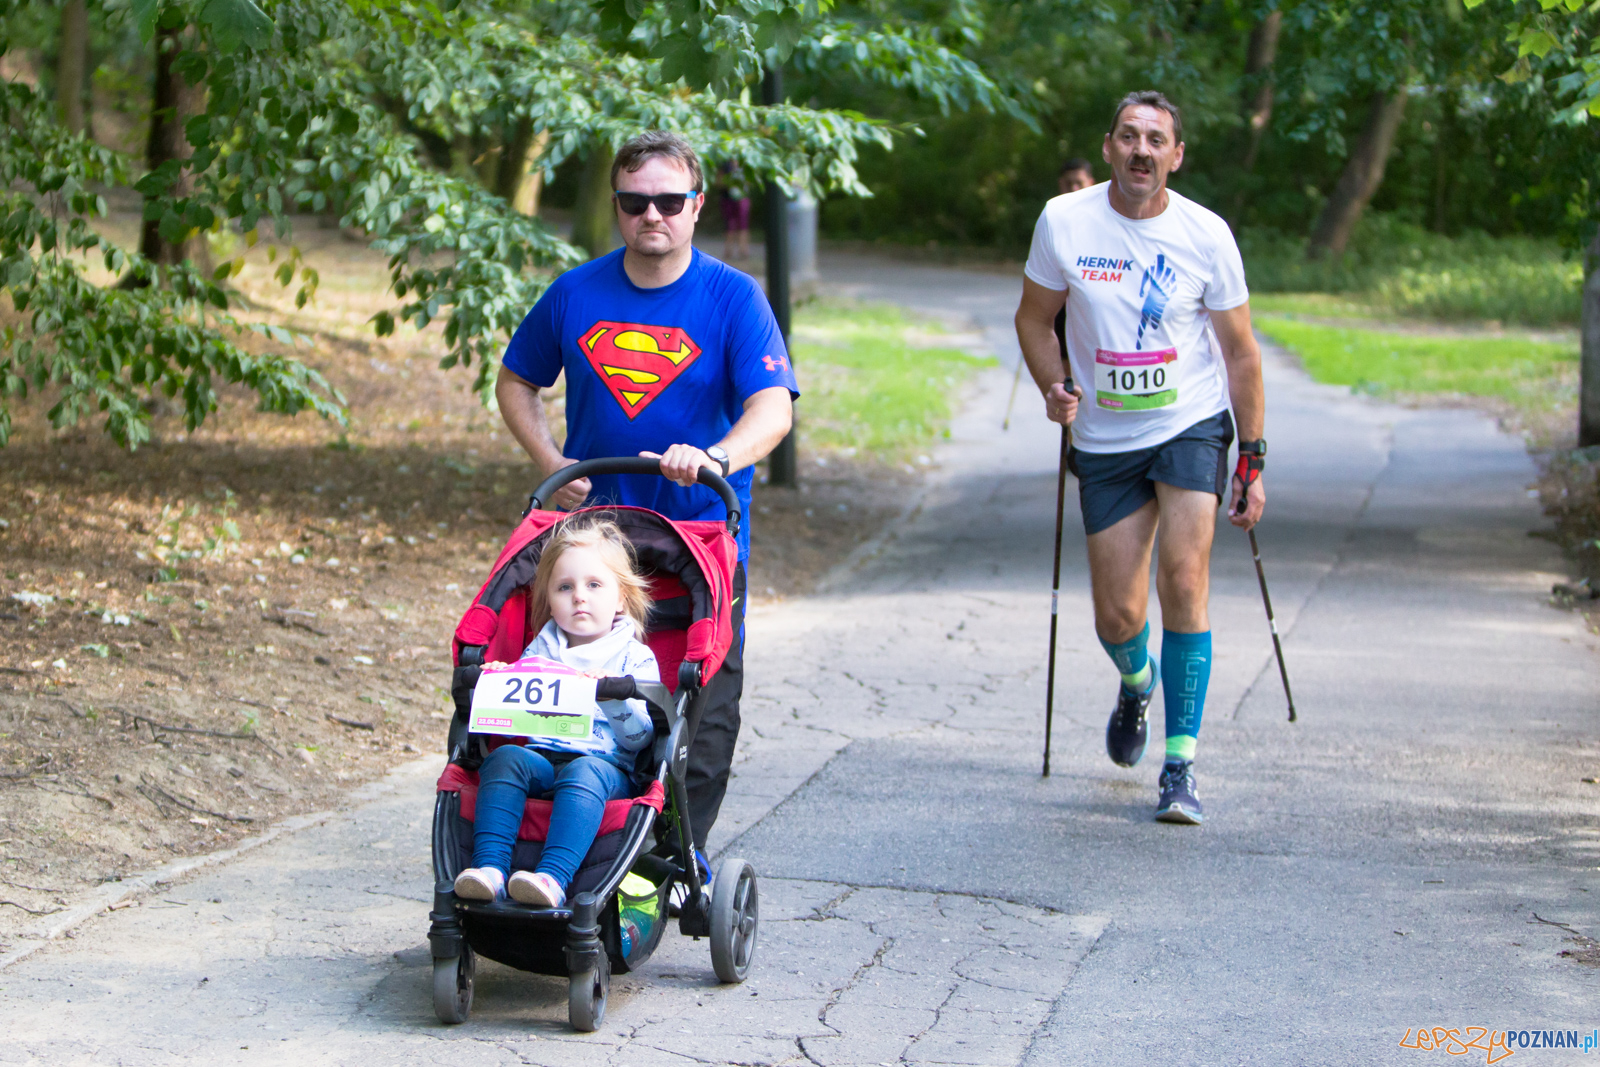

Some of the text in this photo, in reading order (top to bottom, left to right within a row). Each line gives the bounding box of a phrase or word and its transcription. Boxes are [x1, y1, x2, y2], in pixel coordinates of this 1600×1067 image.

[1077, 256, 1134, 271] HERNIK
[1081, 269, 1123, 283] TEAM
[1107, 367, 1166, 391] 1010
[502, 677, 561, 706] 261
